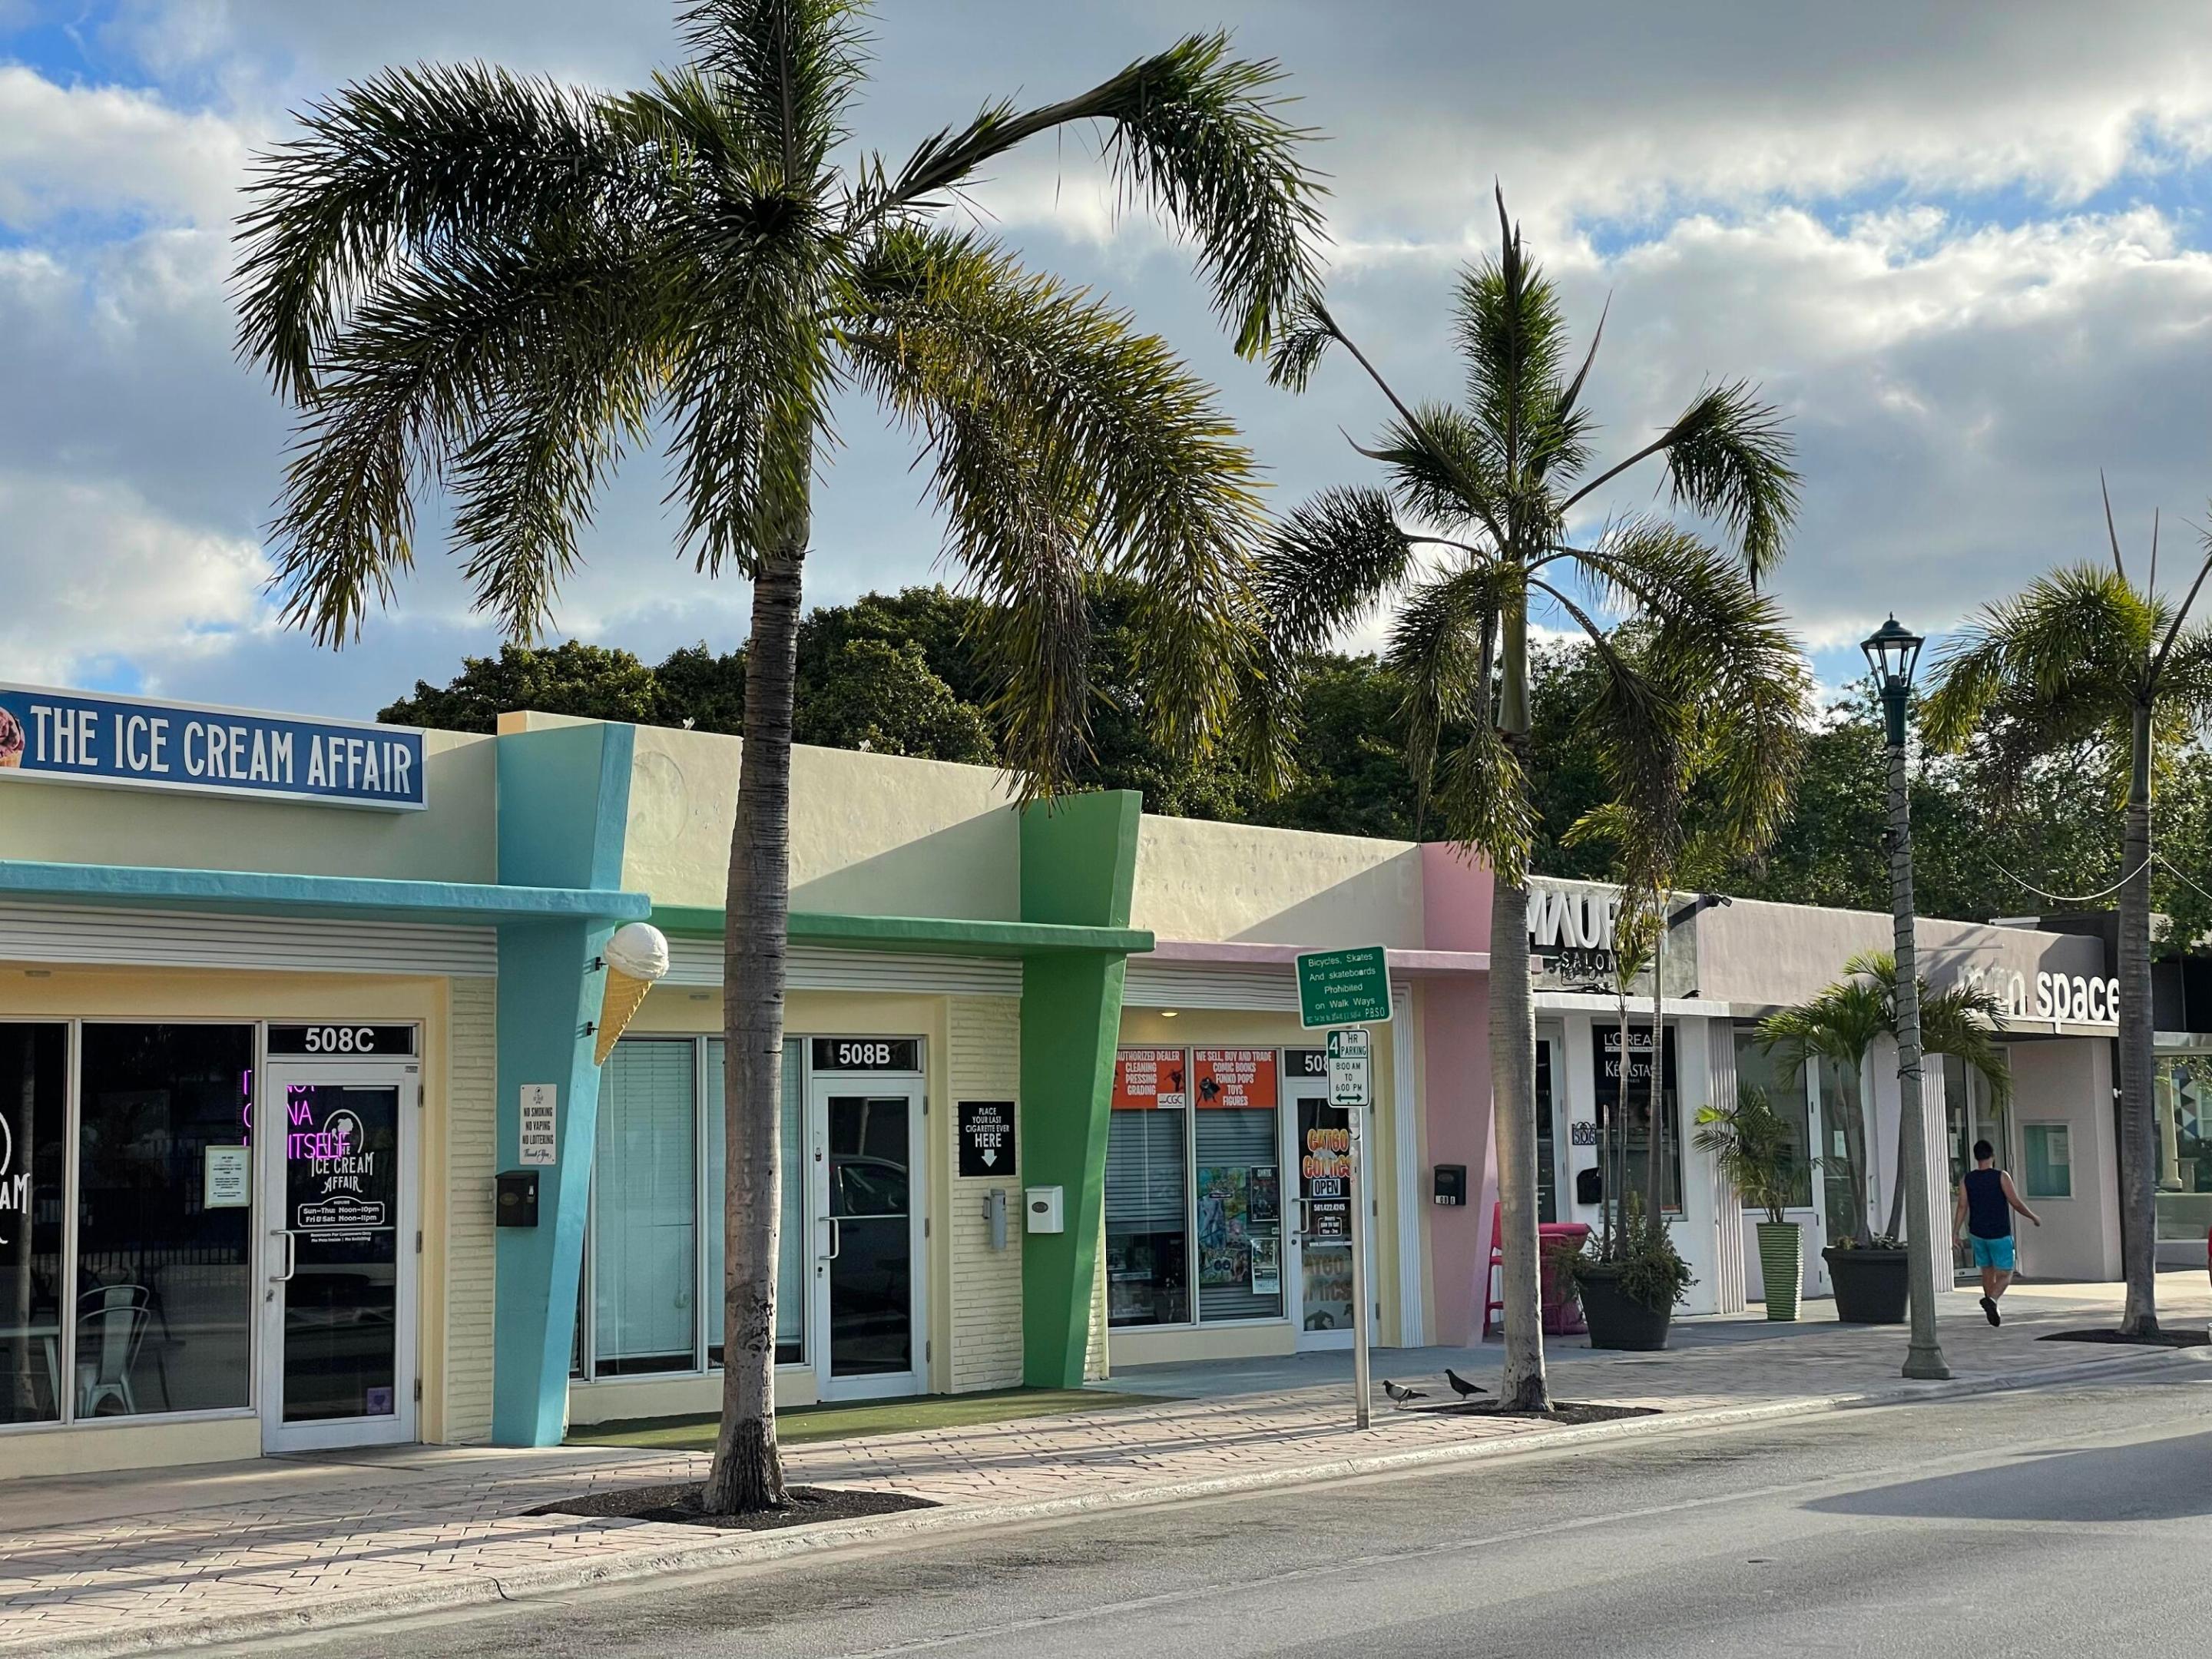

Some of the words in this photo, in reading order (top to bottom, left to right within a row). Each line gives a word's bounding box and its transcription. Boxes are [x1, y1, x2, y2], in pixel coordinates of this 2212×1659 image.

[30, 705, 98, 766] THE
[114, 714, 169, 773] ICE
[184, 720, 293, 784] CREAM
[307, 734, 412, 794] AFFAIR
[1308, 956, 1342, 968] Bicycles,
[1346, 953, 1373, 962] Skates
[1310, 972, 1324, 982] And
[1329, 967, 1376, 979] skateboards
[1324, 983, 1363, 994] Prohibited
[1330, 998, 1349, 1008] Walk
[1353, 998, 1375, 1007] Ways
[2037, 971, 2120, 1034] space
[305, 1027, 375, 1052] 508C
[1348, 1034, 1358, 1044] HR
[1604, 1031, 1653, 1046] L'ORÉA
[1329, 1035, 1339, 1055] 4
[1341, 1045, 1366, 1056] PARKING
[839, 1044, 891, 1065] 508B
[1117, 1051, 1155, 1061] AUTHORIZED
[1156, 1051, 1180, 1061] DEALER
[1196, 1051, 1206, 1061] WE
[1224, 1051, 1237, 1061] BUY
[1238, 1051, 1251, 1061] AND
[1252, 1051, 1272, 1061] TRADE
[1125, 1062, 1157, 1073] CLEANING
[1213, 1062, 1234, 1072] COMIC
[1235, 1062, 1257, 1072] BOOKS
[1125, 1074, 1157, 1084] PRESSING
[1215, 1074, 1237, 1084] FUNKO
[1237, 1073, 1254, 1084] POPS
[1345, 1073, 1353, 1081] TO
[1127, 1084, 1156, 1095] GRADING
[1227, 1084, 1243, 1095] TOYS
[1336, 1083, 1349, 1091] 6:00
[1167, 1094, 1183, 1104] CGC
[1222, 1095, 1248, 1106] FIGURES
[524, 1108, 530, 1117] NO
[531, 1107, 552, 1117] SMOKING
[979, 1107, 996, 1115] PLACE
[525, 1121, 531, 1131] NO
[533, 1121, 551, 1131] VAPING
[965, 1124, 995, 1133] CIGARETTE
[522, 1135, 528, 1144] NO
[529, 1134, 553, 1144] LOITERING
[975, 1133, 1002, 1147] HERE
[1575, 1130, 1594, 1144] 506
[288, 1132, 350, 1159] ITSELF
[310, 1153, 329, 1177] ICE
[333, 1151, 375, 1176] CREAM
[320, 1176, 363, 1194] AFFAIR
[1315, 1180, 1339, 1194] OPEN
